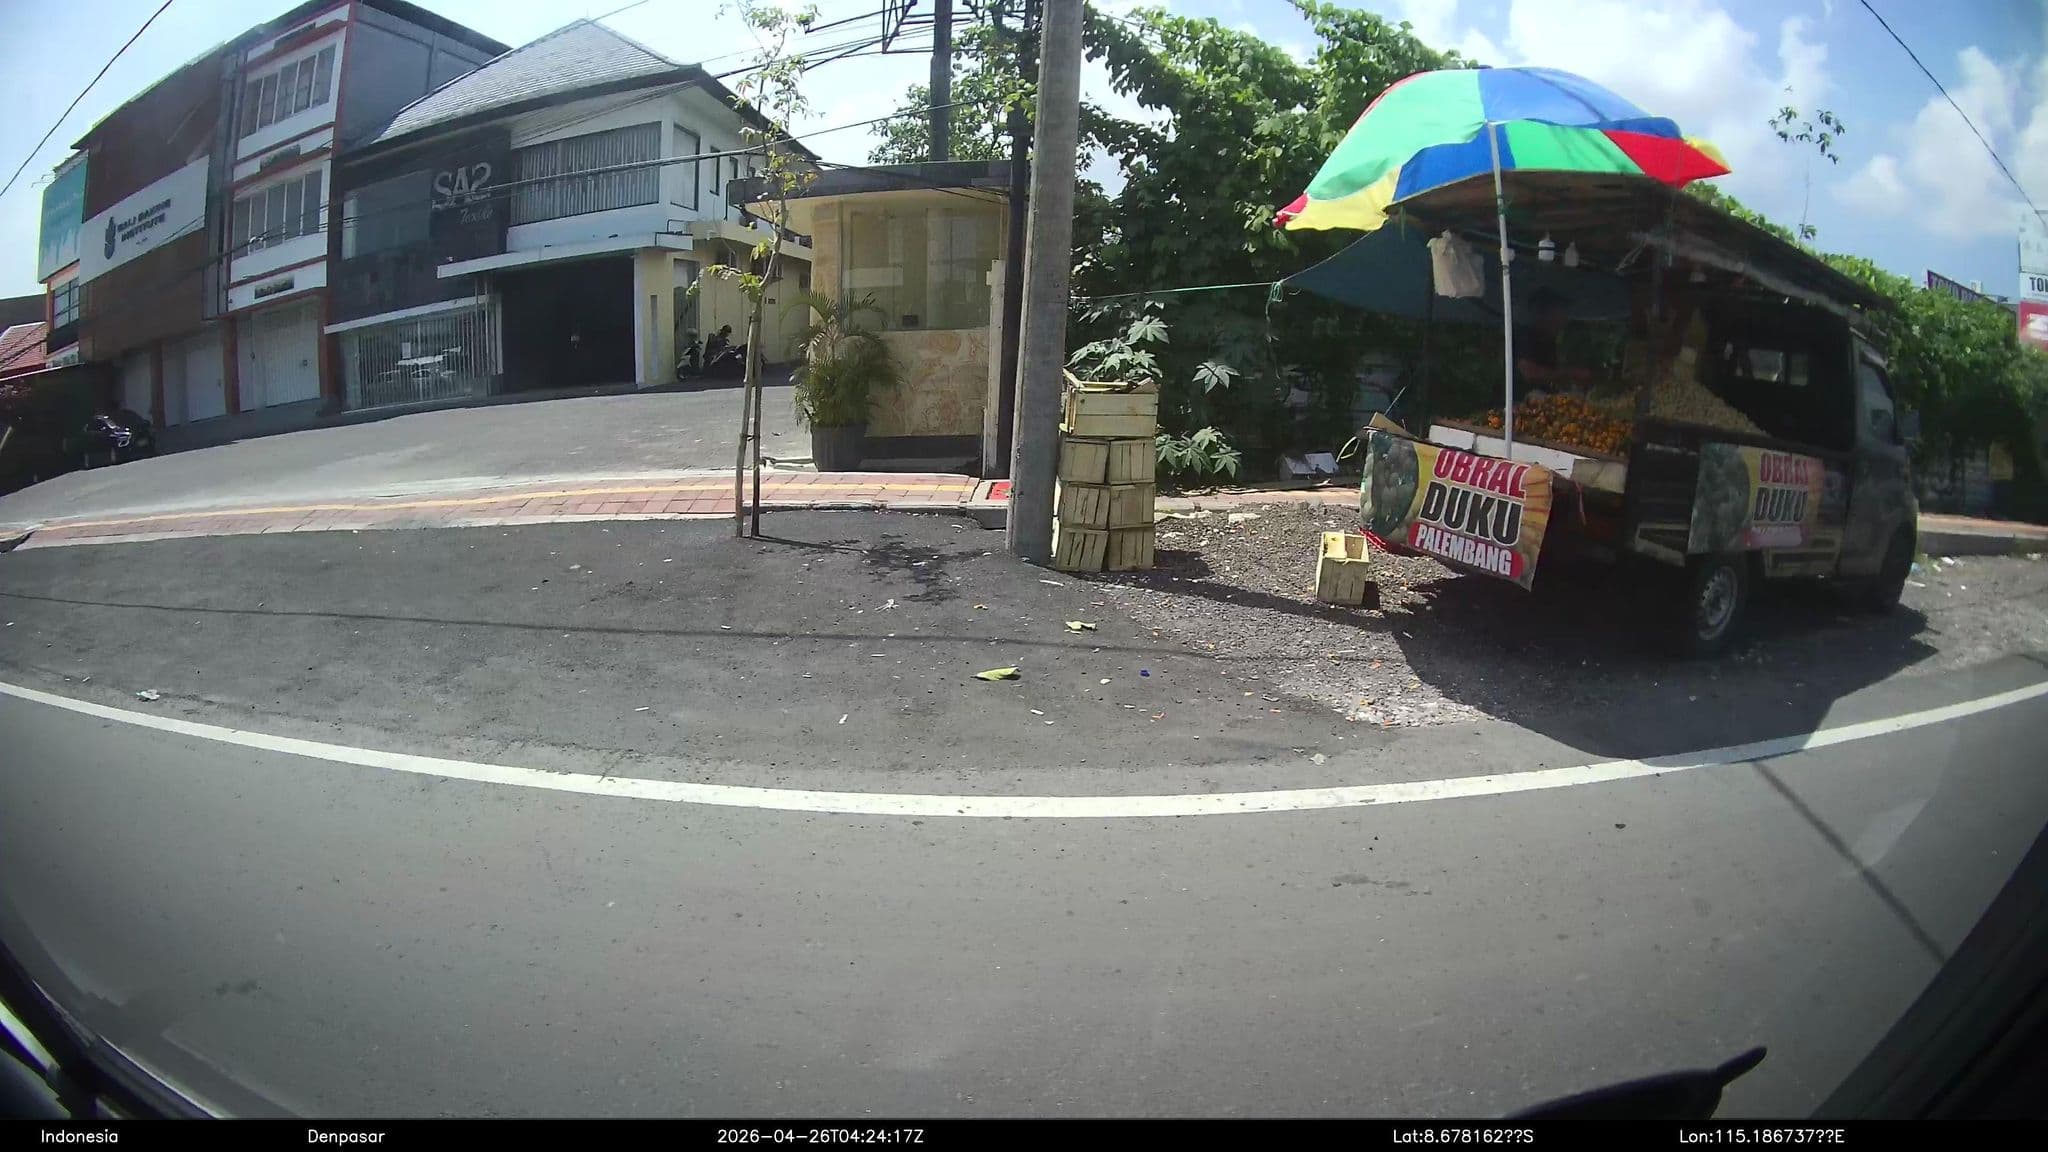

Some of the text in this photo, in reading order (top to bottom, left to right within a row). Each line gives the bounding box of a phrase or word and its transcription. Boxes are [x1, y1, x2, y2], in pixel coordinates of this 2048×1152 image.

[121, 213, 166, 242] INSTITUTE
[1433, 449, 1531, 499] OBRAL
[1420, 481, 1523, 546] DUKU
[1753, 487, 1809, 522] DUKU
[1415, 524, 1513, 576] PALEMBANG
